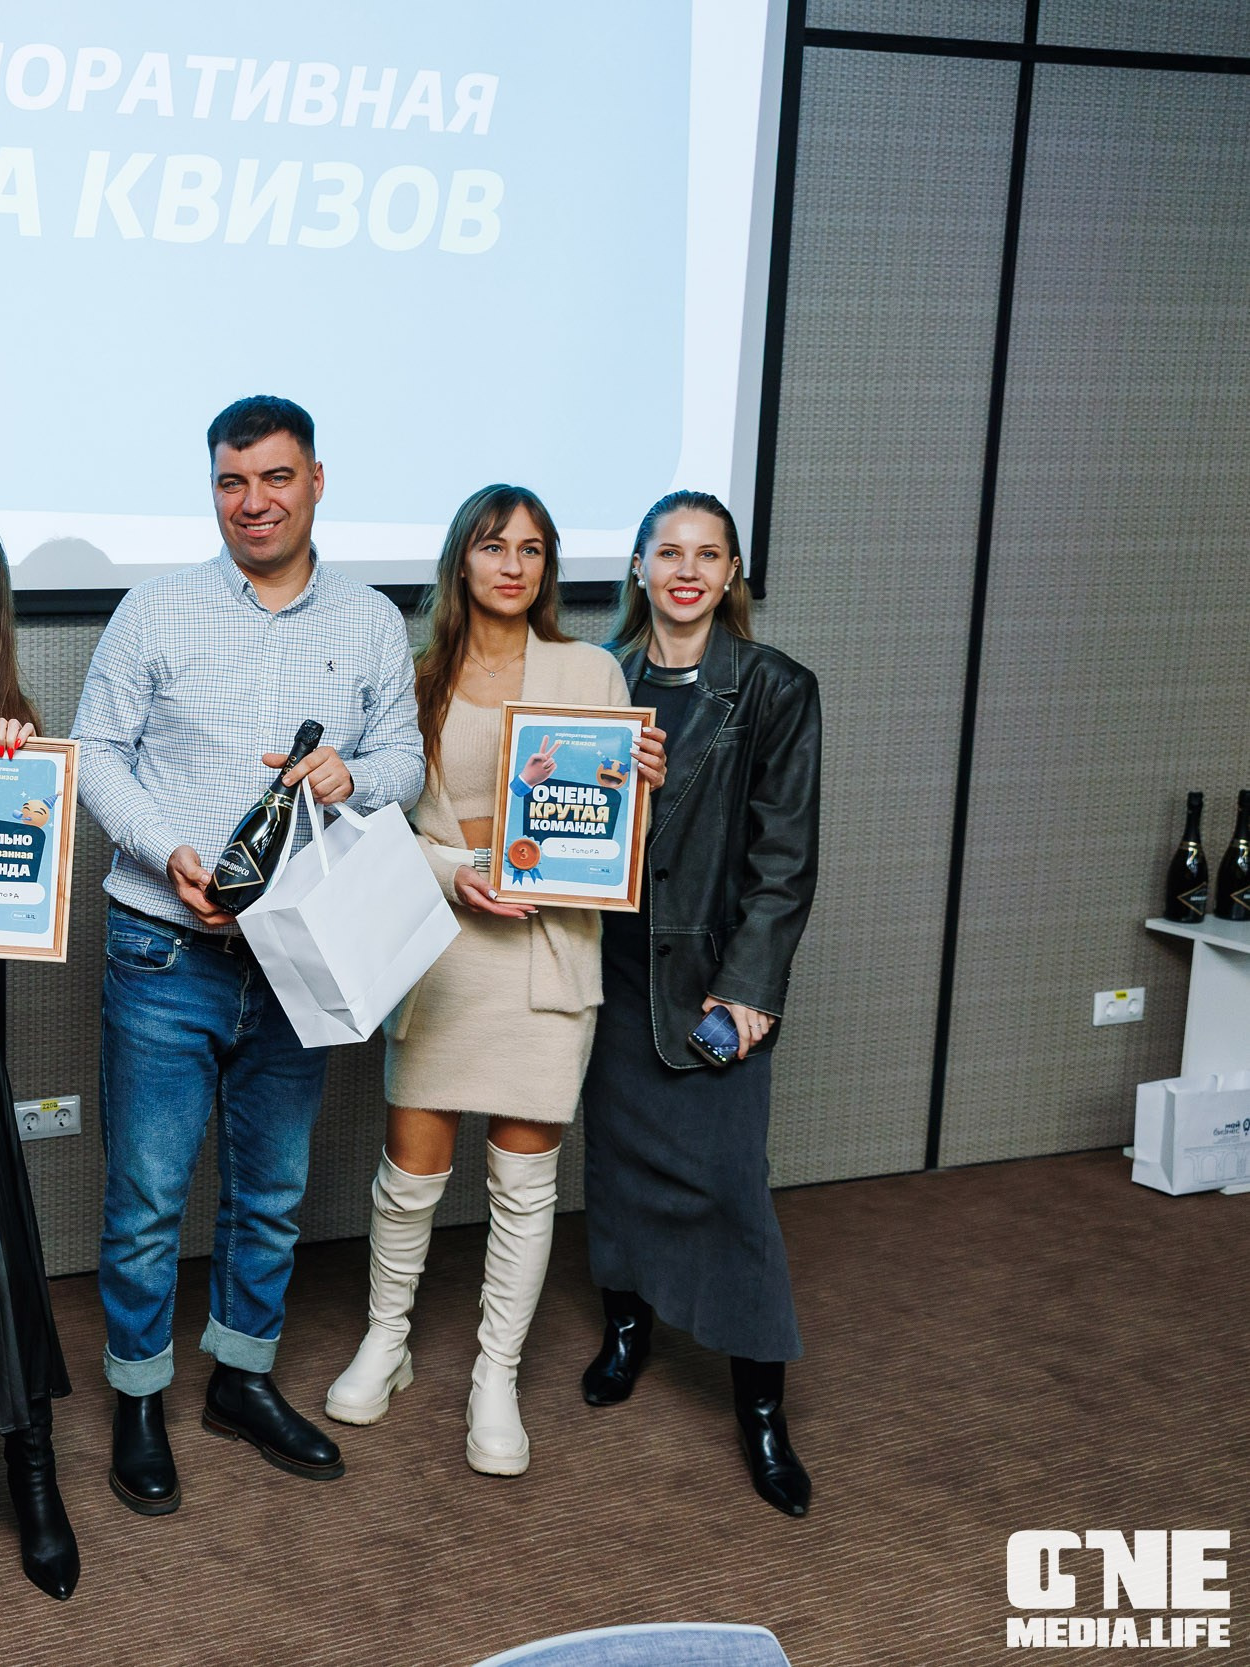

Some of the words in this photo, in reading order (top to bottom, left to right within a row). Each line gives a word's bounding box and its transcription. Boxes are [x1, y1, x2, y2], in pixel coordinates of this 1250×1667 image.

[73, 150, 506, 255] КВИЗОВ
[532, 785, 608, 806] ОЧЕНЬ
[529, 802, 610, 823] КРУТАЯ
[530, 819, 607, 835] КОМАНДА
[519, 847, 528, 860] 3
